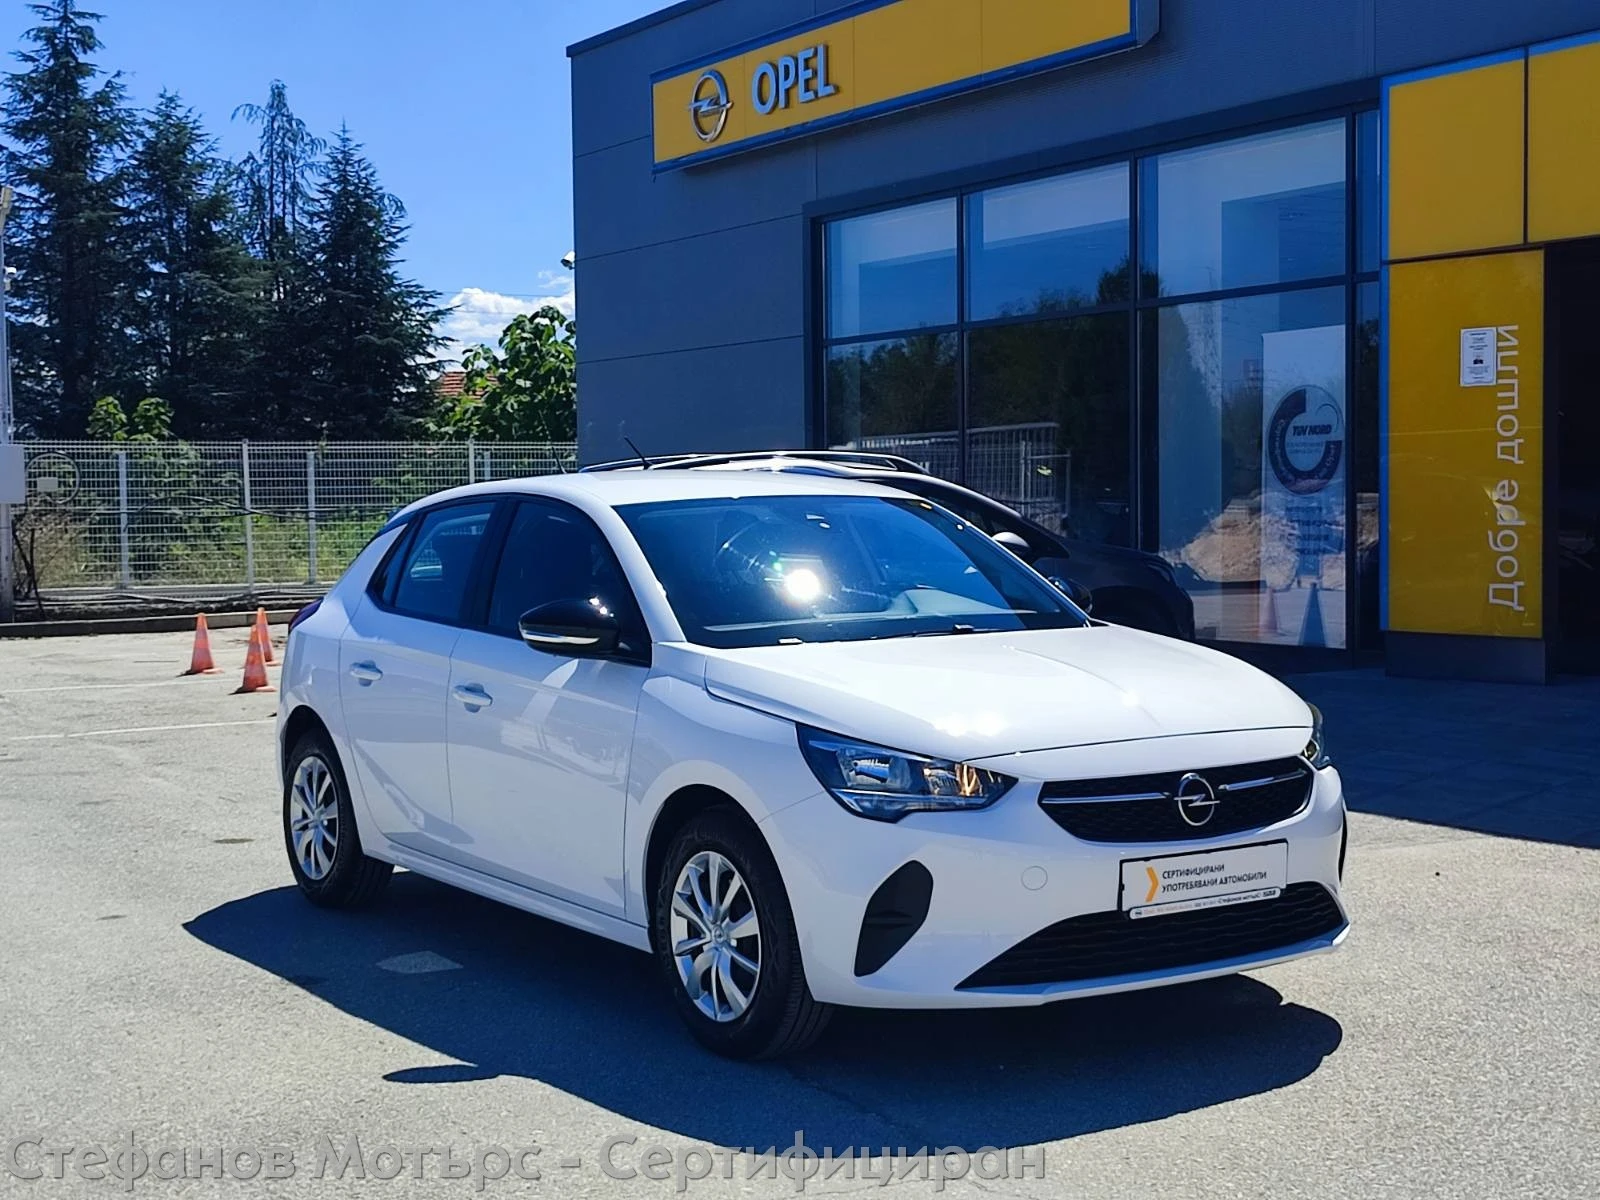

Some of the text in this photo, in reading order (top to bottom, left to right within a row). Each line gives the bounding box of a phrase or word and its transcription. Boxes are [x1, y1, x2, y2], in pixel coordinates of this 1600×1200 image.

[751, 44, 837, 115] OPEL
[1488, 324, 1526, 612] Добре дошли
[1161, 871, 1267, 893] УПОТРЕБЯВАНИ АВТОМОБИЛИ
[1162, 864, 1225, 879] СЕРТИФИЦИРАНИ
